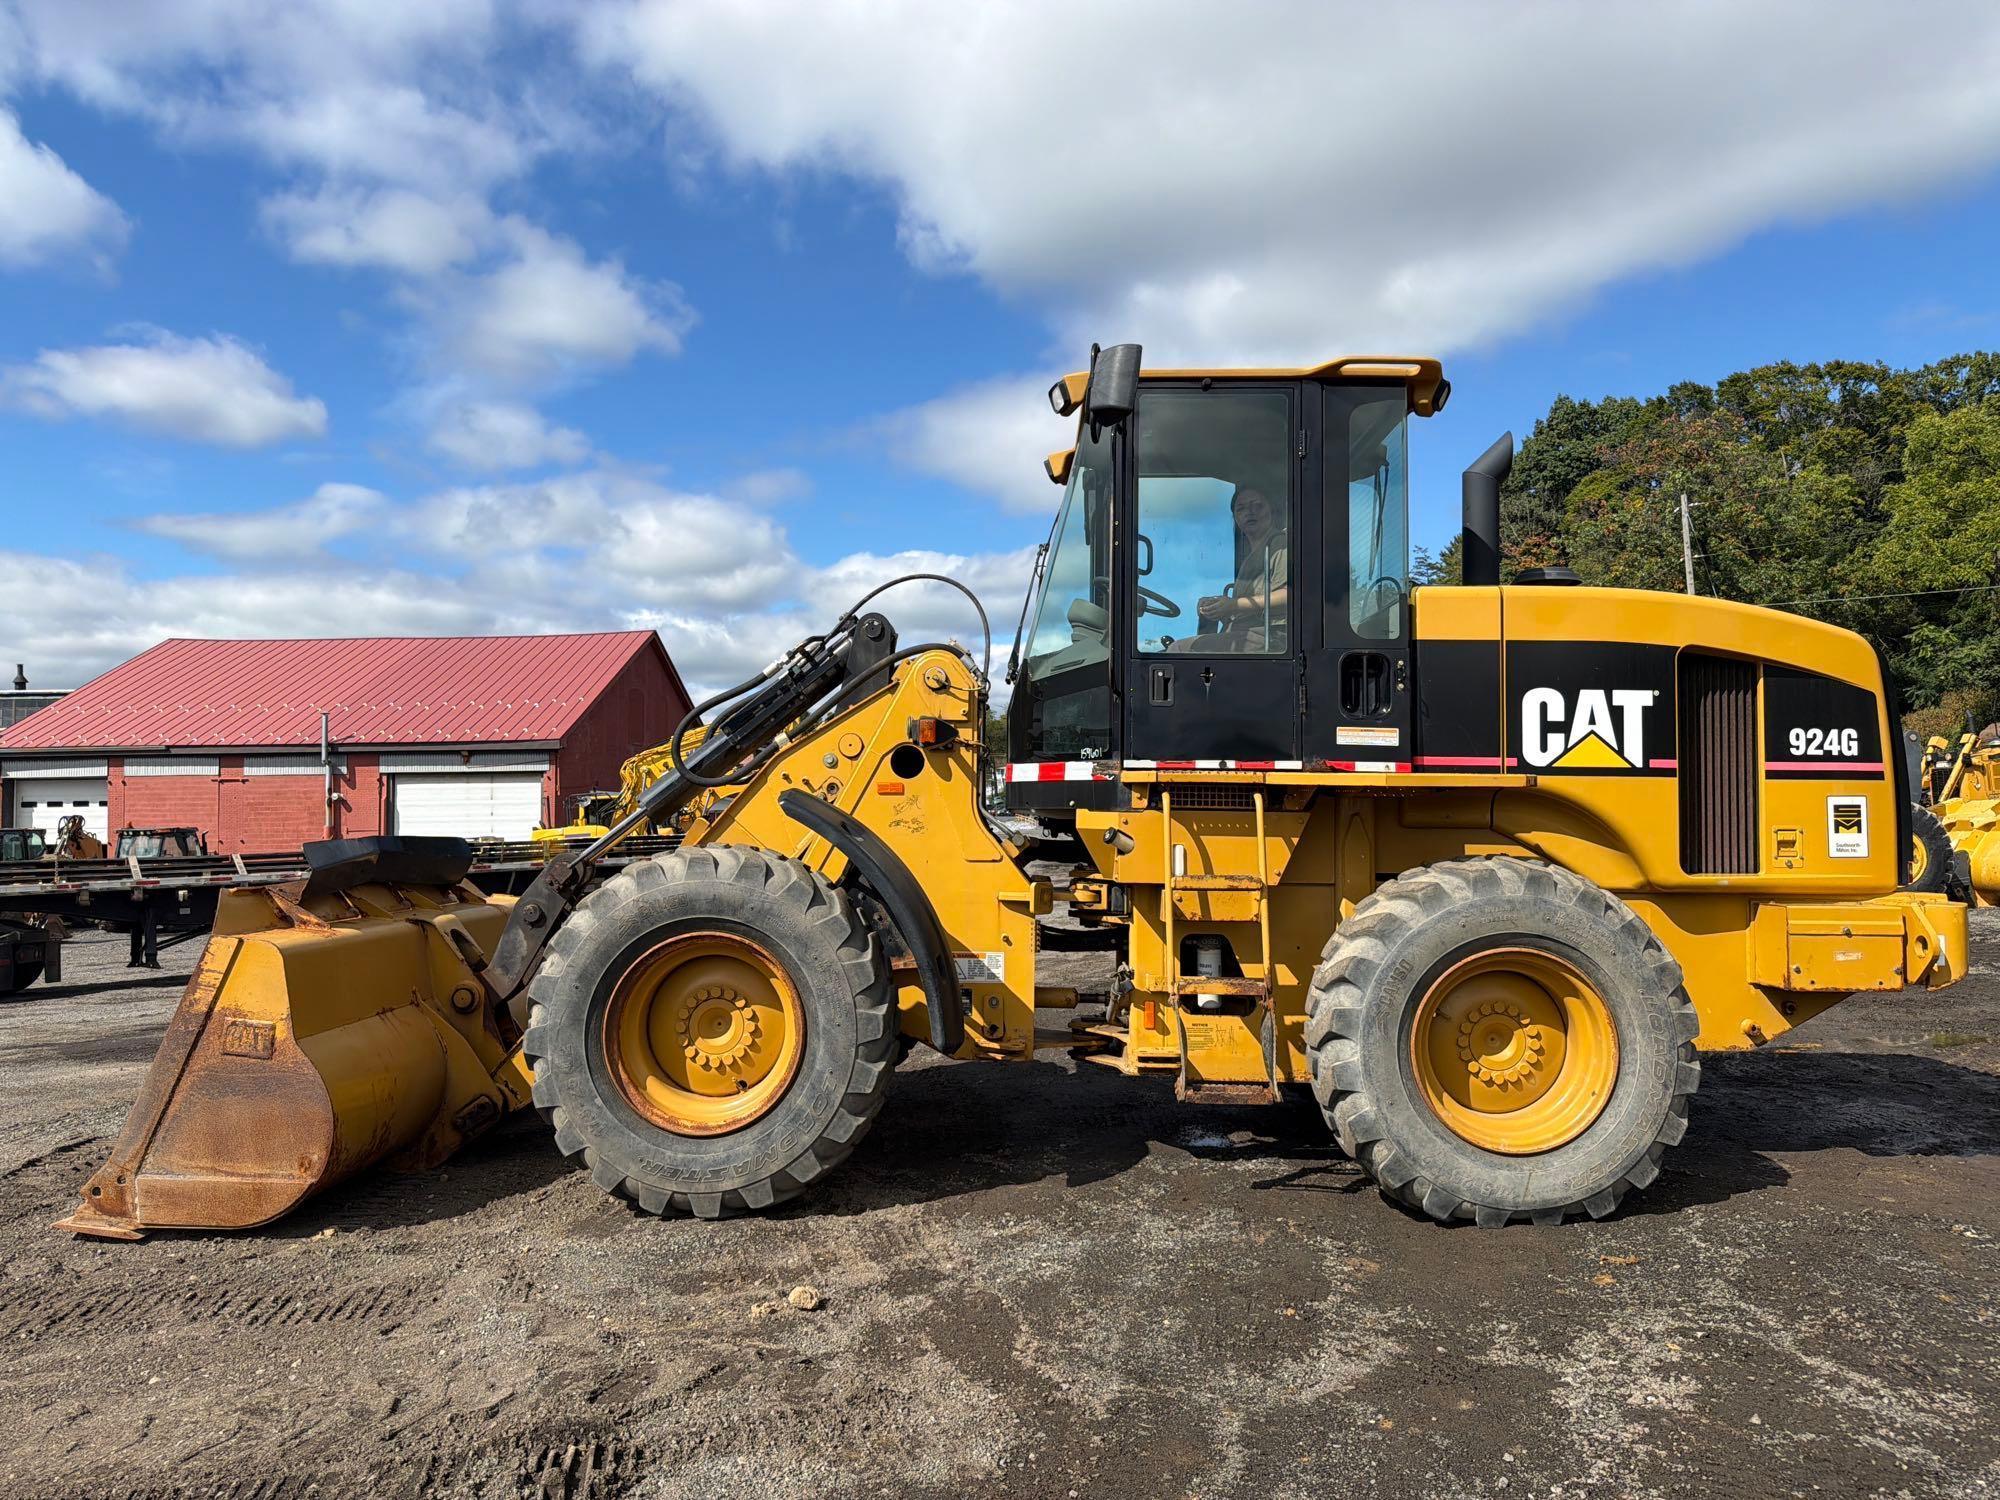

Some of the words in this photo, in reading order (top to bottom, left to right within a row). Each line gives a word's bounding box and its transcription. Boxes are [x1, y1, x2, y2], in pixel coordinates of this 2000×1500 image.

[1522, 687, 1653, 768] CAT
[1789, 727, 1858, 757] 924G
[639, 1073, 838, 1184] LOADMASTER
[1570, 994, 1671, 1191] LOADMASTER
